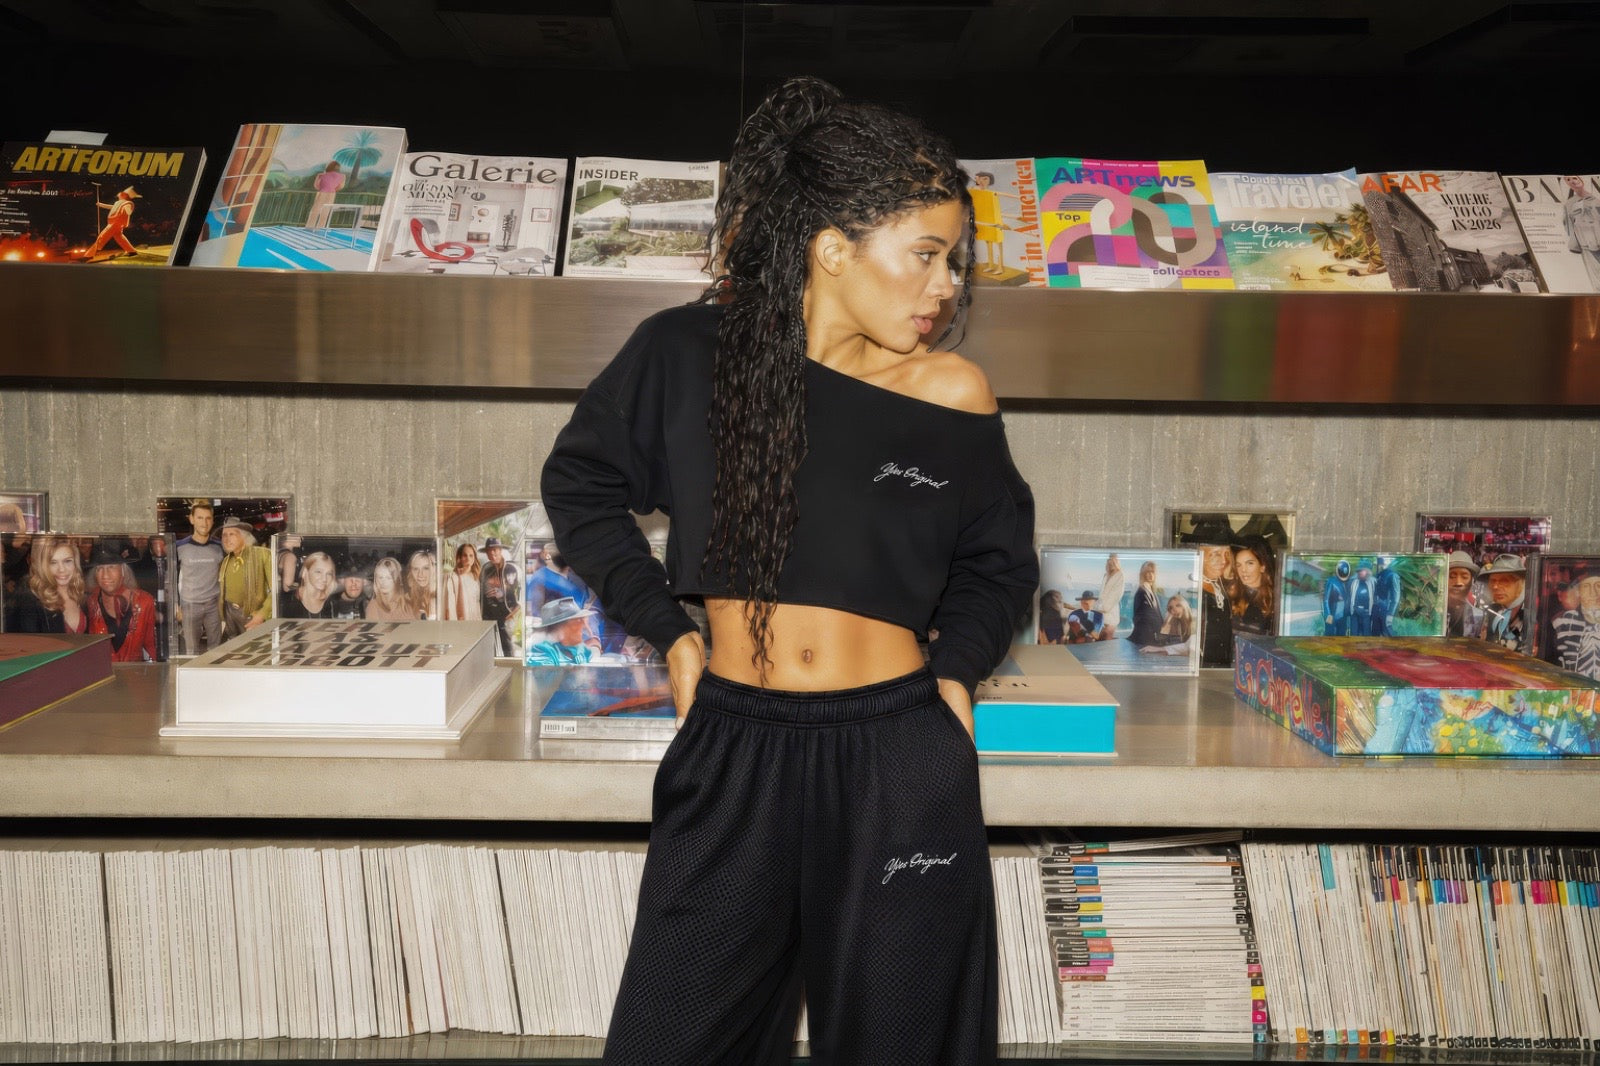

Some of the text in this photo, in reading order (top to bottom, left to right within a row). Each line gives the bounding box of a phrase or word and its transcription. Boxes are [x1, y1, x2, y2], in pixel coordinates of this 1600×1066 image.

[12, 146, 184, 178] ARTFORUM
[409, 154, 557, 184] Galerie
[579, 169, 639, 181] INSIDER
[1051, 167, 1196, 188] ARTnews
[1362, 173, 1443, 193] AFAR
[1012, 160, 1040, 238] America
[1218, 174, 1352, 211] Traveler
[1440, 193, 1492, 206] WHERE
[1056, 212, 1081, 222] Top
[1450, 206, 1492, 218] TO GO
[1230, 216, 1305, 234] island
[1467, 219, 1502, 231] 2026
[1252, 232, 1316, 249] time
[1020, 242, 1043, 261] in
[909, 852, 958, 875] Original
